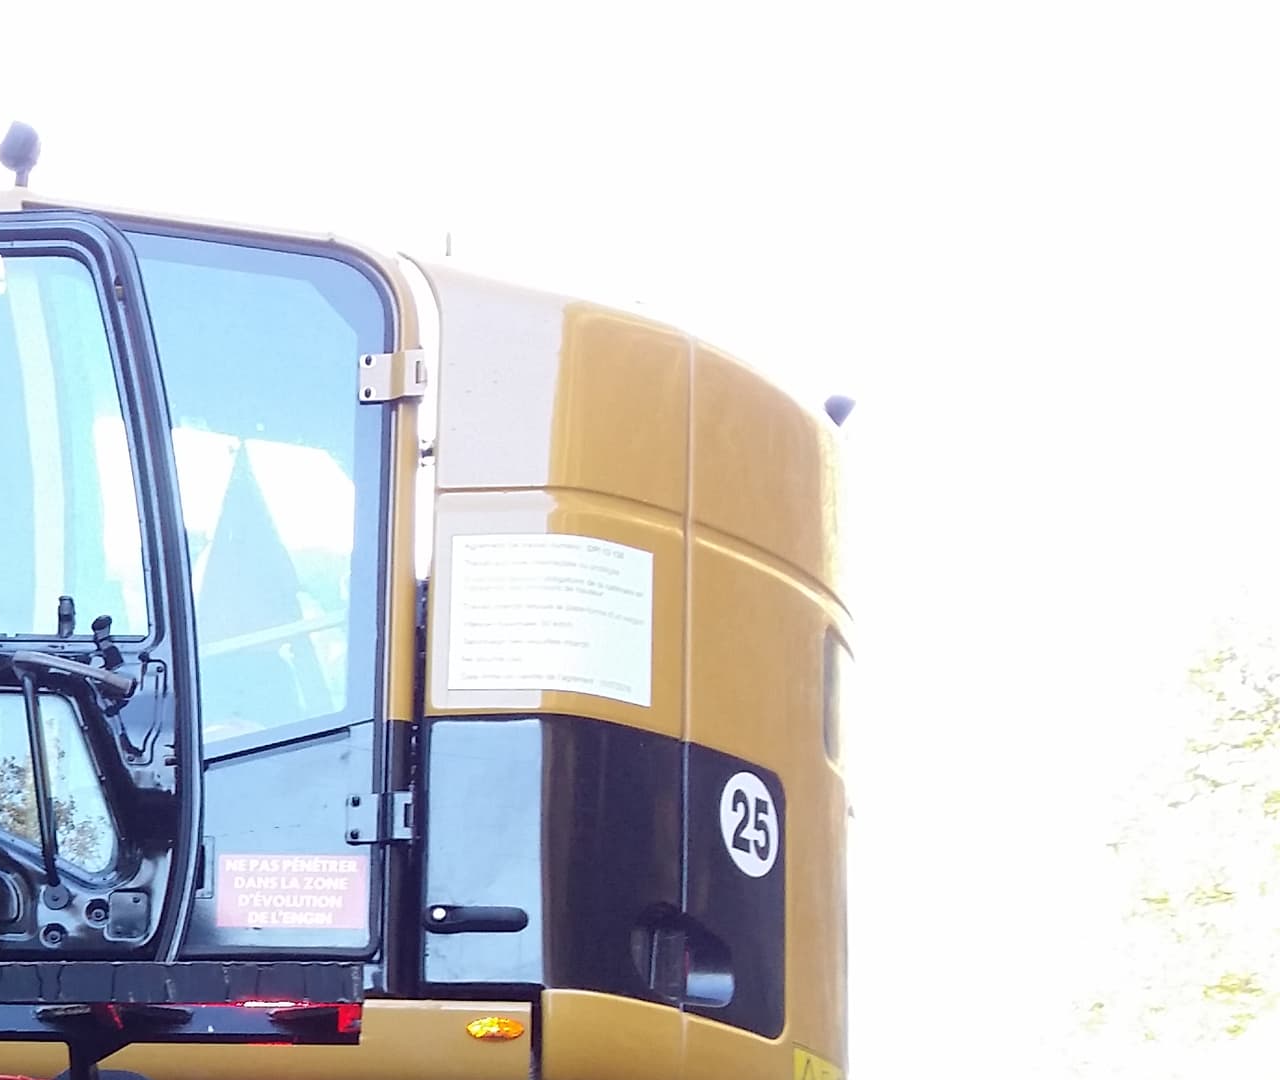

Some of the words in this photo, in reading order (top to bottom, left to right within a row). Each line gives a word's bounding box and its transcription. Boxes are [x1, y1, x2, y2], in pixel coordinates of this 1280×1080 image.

[731, 788, 771, 862] 25
[224, 859, 246, 873] NE
[248, 859, 281, 873] PAS
[282, 857, 358, 873] PÉNÉTRER
[233, 876, 278, 889] DANS
[280, 876, 300, 889] LA
[303, 877, 348, 890] ZONE
[238, 892, 343, 908] D'ÉVOLUTION
[247, 911, 272, 924] DE
[273, 911, 333, 925] L'ENGIN
